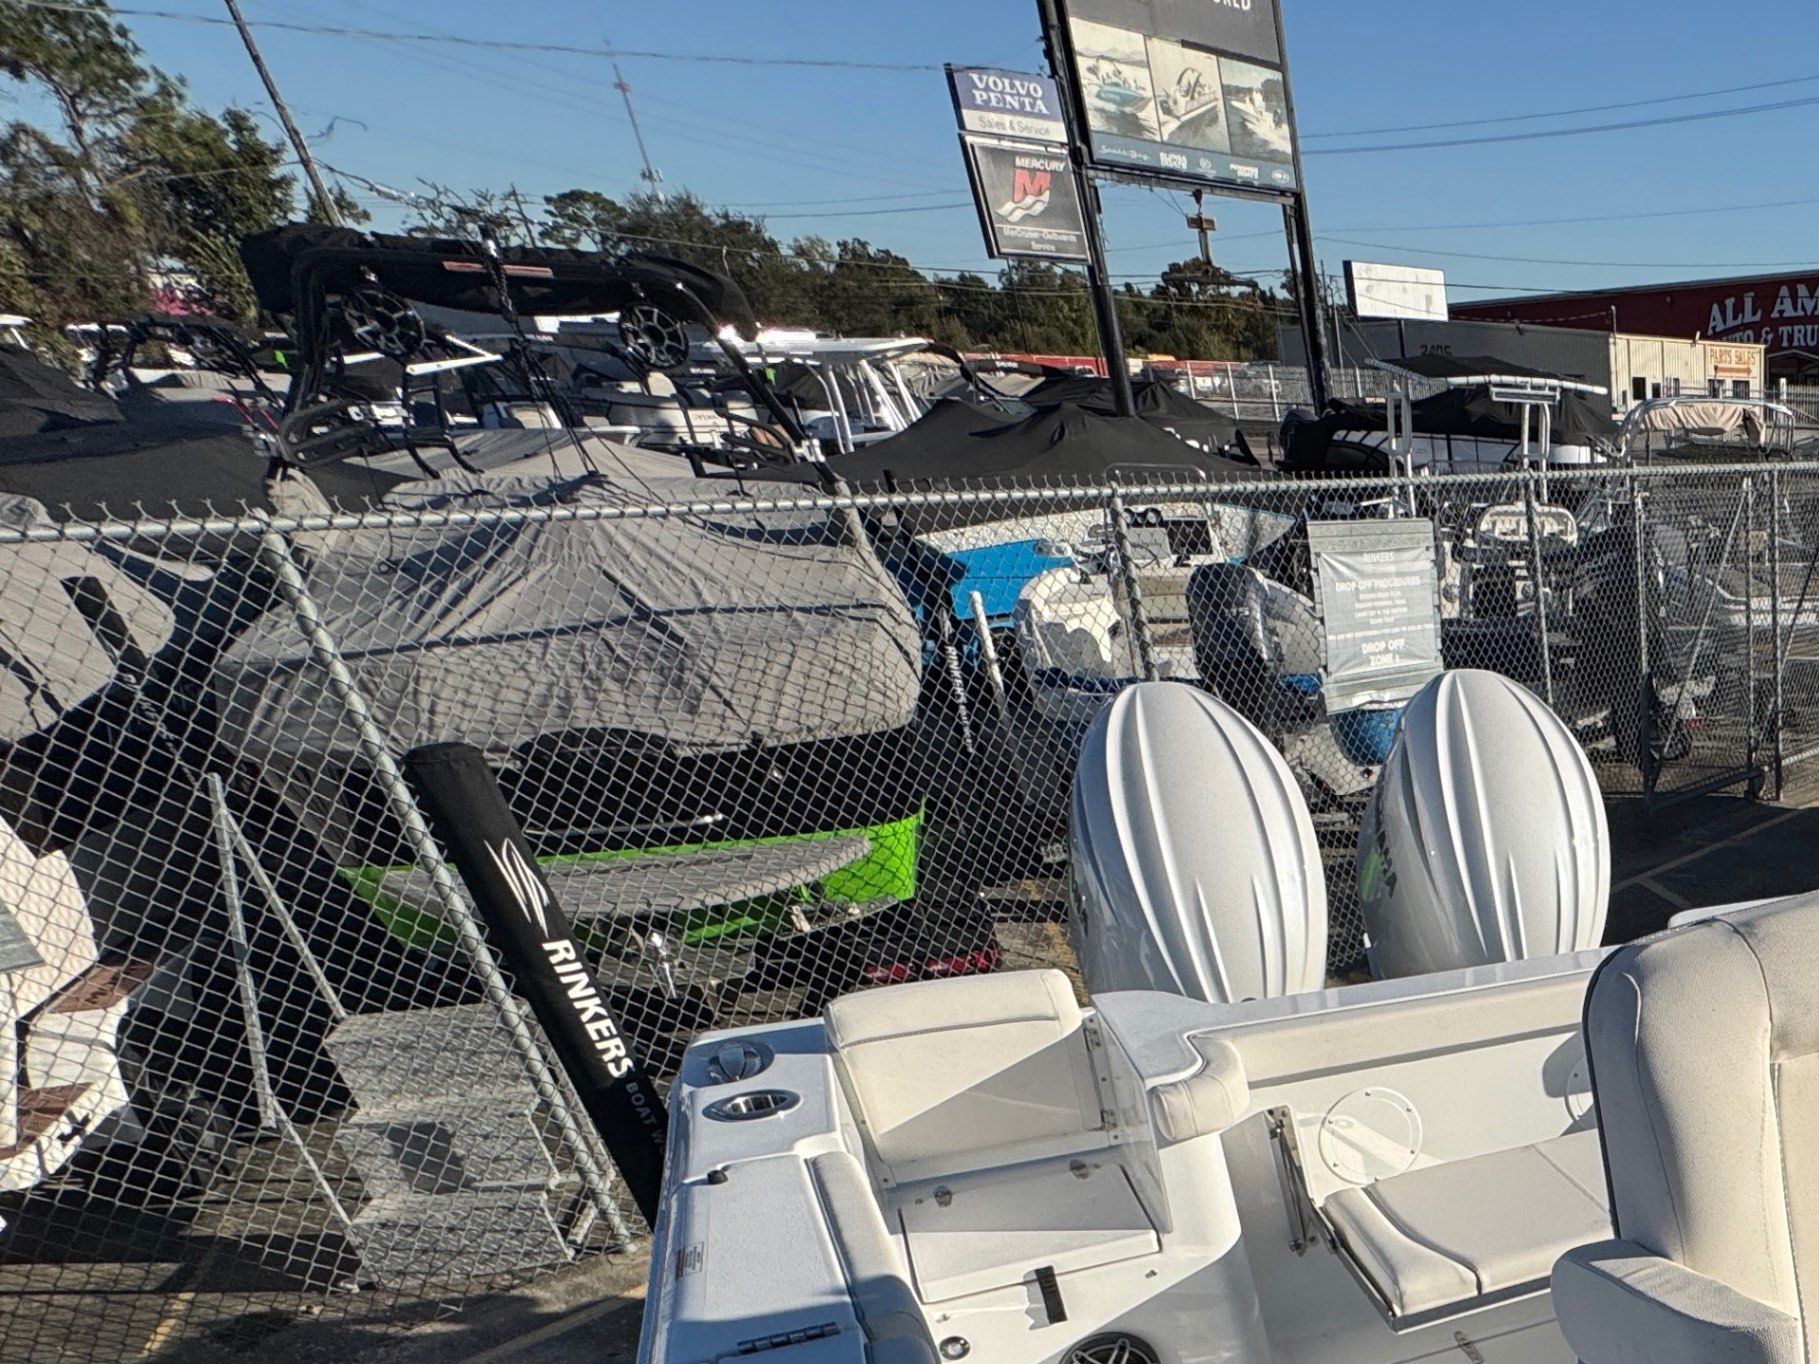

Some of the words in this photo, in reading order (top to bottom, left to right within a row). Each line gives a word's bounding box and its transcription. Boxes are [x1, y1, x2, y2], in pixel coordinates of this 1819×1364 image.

[969, 73, 1043, 98] VOLVO
[971, 89, 1050, 115] PENTA
[1015, 155, 1066, 172] MERCURY
[1707, 291, 1762, 336] ALL
[1761, 327, 1774, 347] &
[1710, 347, 1732, 365] PARTS
[1735, 347, 1756, 366] SALES
[1335, 581, 1356, 592] DROP
[1361, 640, 1387, 655] DROP
[1387, 638, 1406, 651] OFF
[541, 939, 635, 1078] RINKERS
[625, 1082, 657, 1124] BOAT
